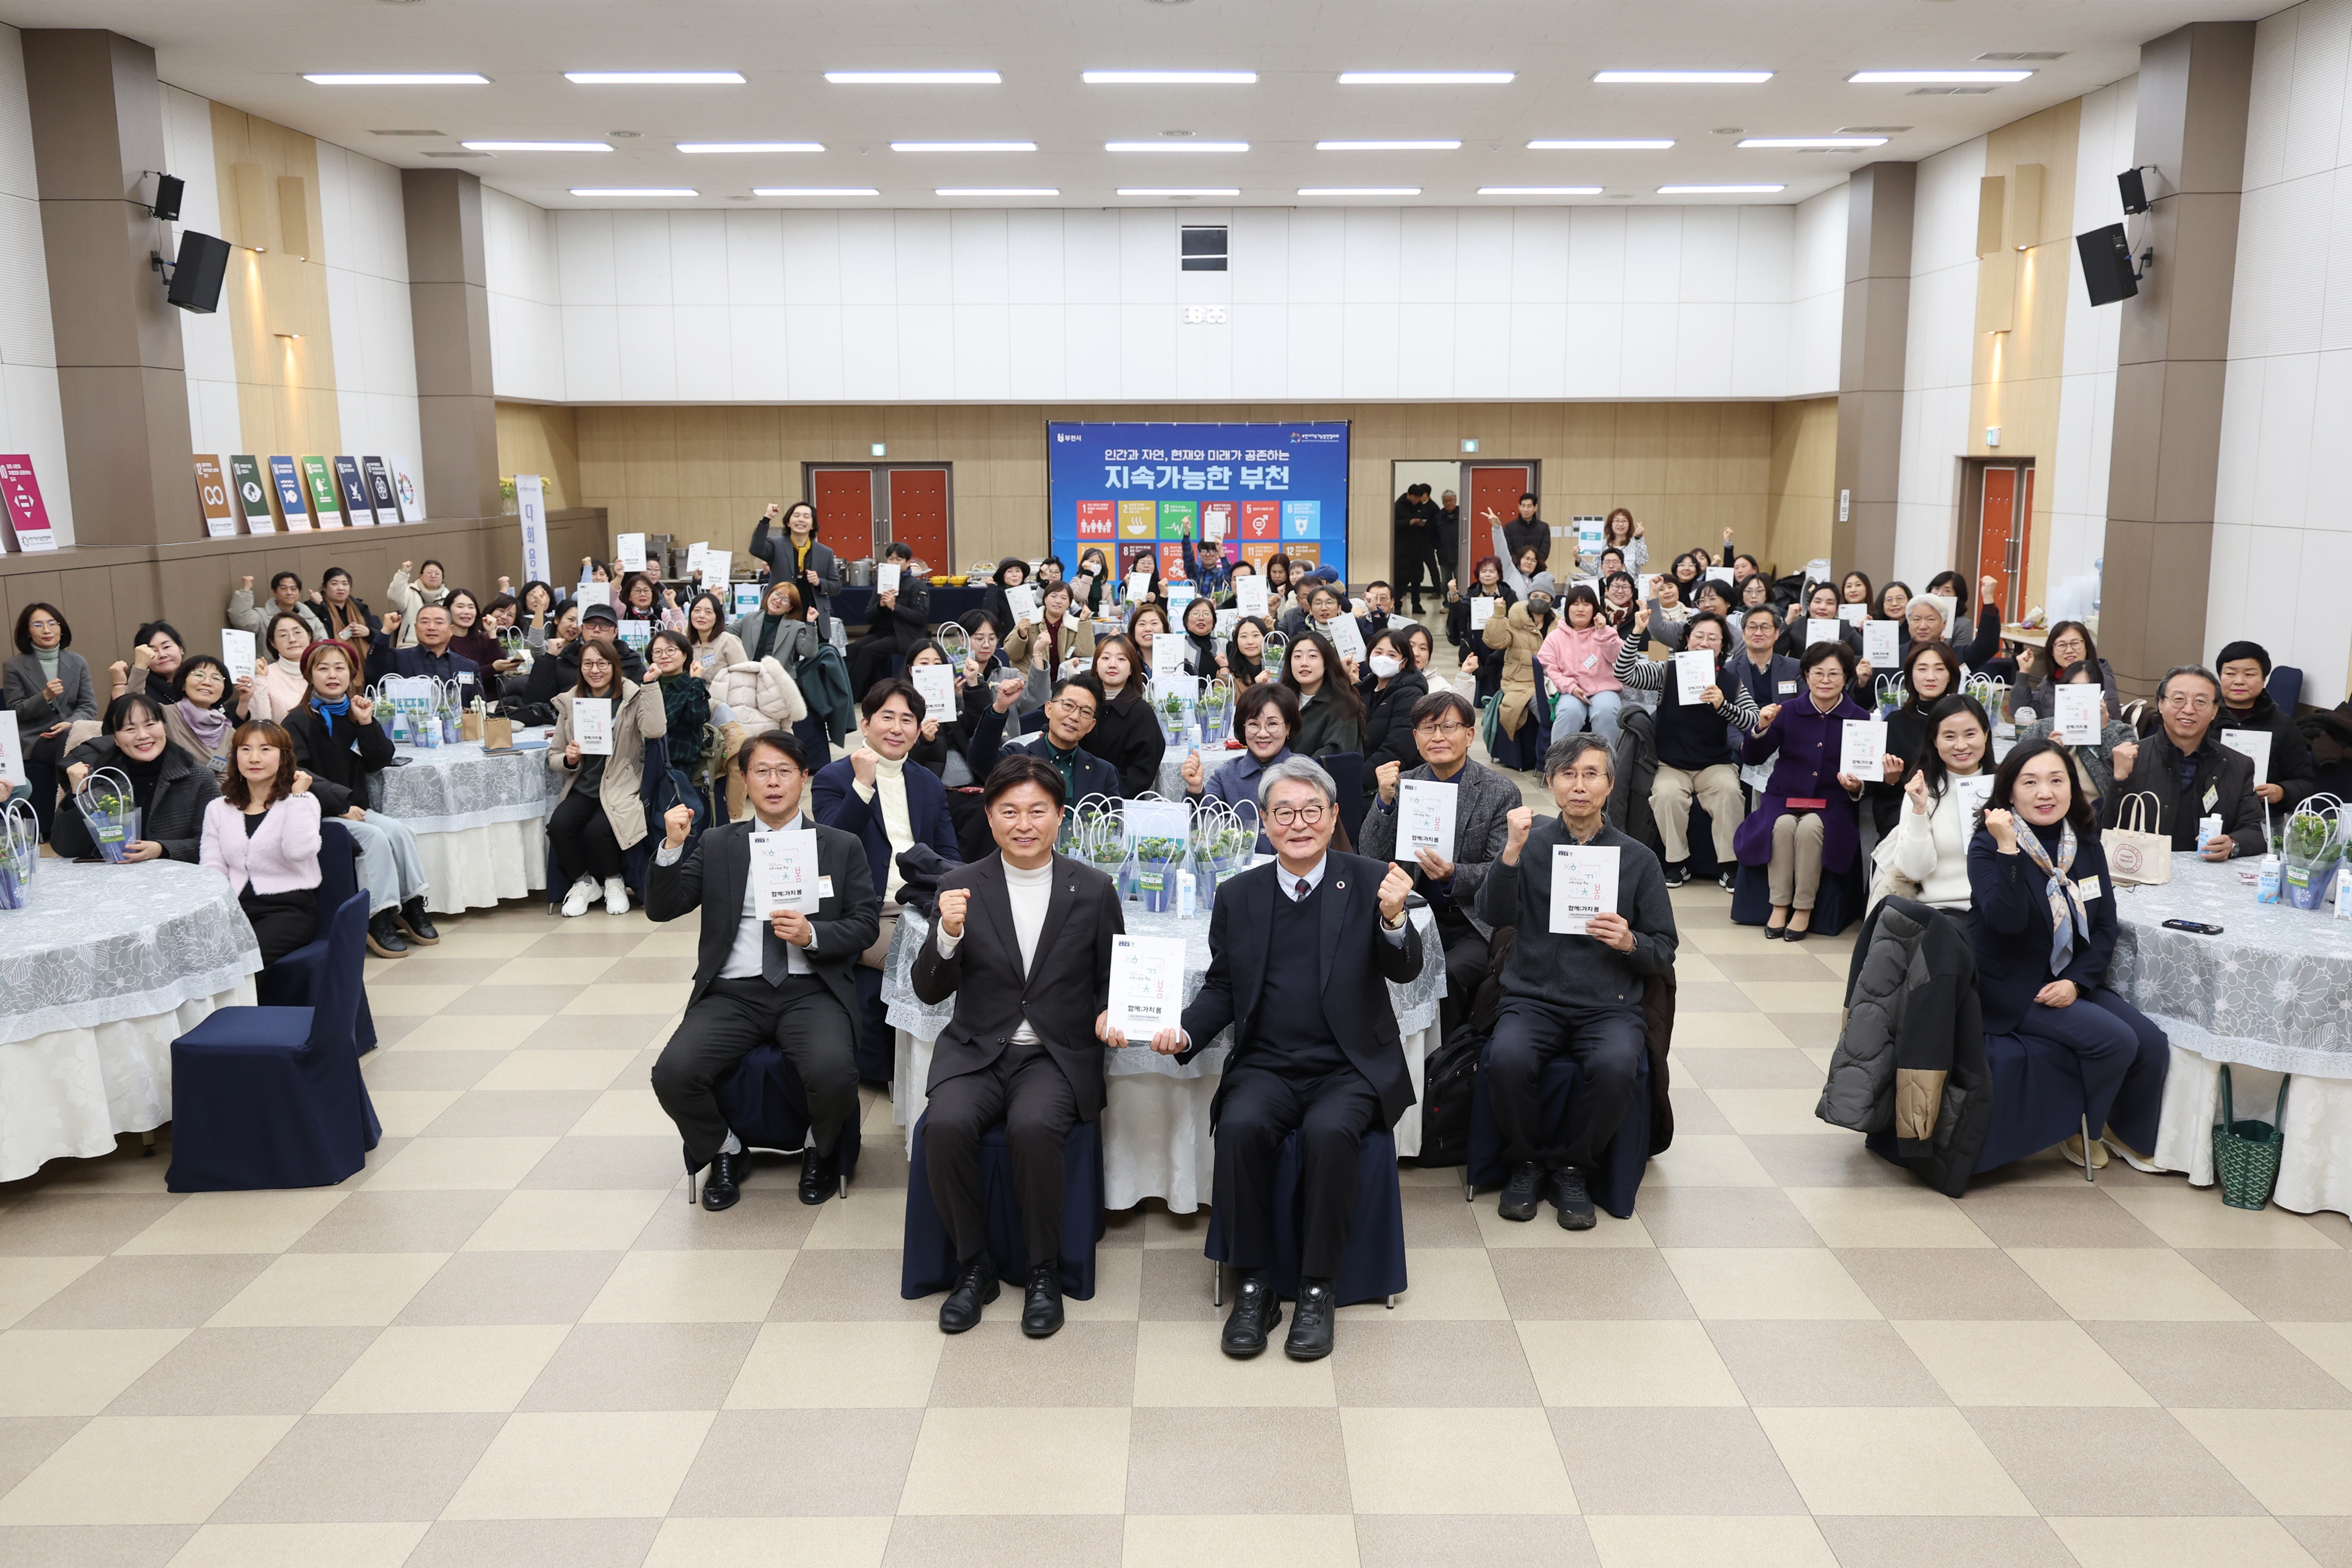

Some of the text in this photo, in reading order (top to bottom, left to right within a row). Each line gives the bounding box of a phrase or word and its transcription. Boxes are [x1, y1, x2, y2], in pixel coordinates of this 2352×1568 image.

[1105, 450, 1290, 462] 인간과 자연, 현재와 미래가 공존하는
[1105, 465, 1289, 491] 지속가능한 부천
[1082, 504, 1086, 513] 1
[1123, 504, 1128, 513] 2
[1164, 504, 1169, 513] 3
[1247, 504, 1251, 514] 5
[1287, 504, 1292, 513] 6
[1081, 546, 1085, 556] 7
[1123, 546, 1129, 556] 8
[1164, 546, 1169, 556] 9
[1247, 547, 1254, 556] 11
[1286, 546, 1294, 556] 12
